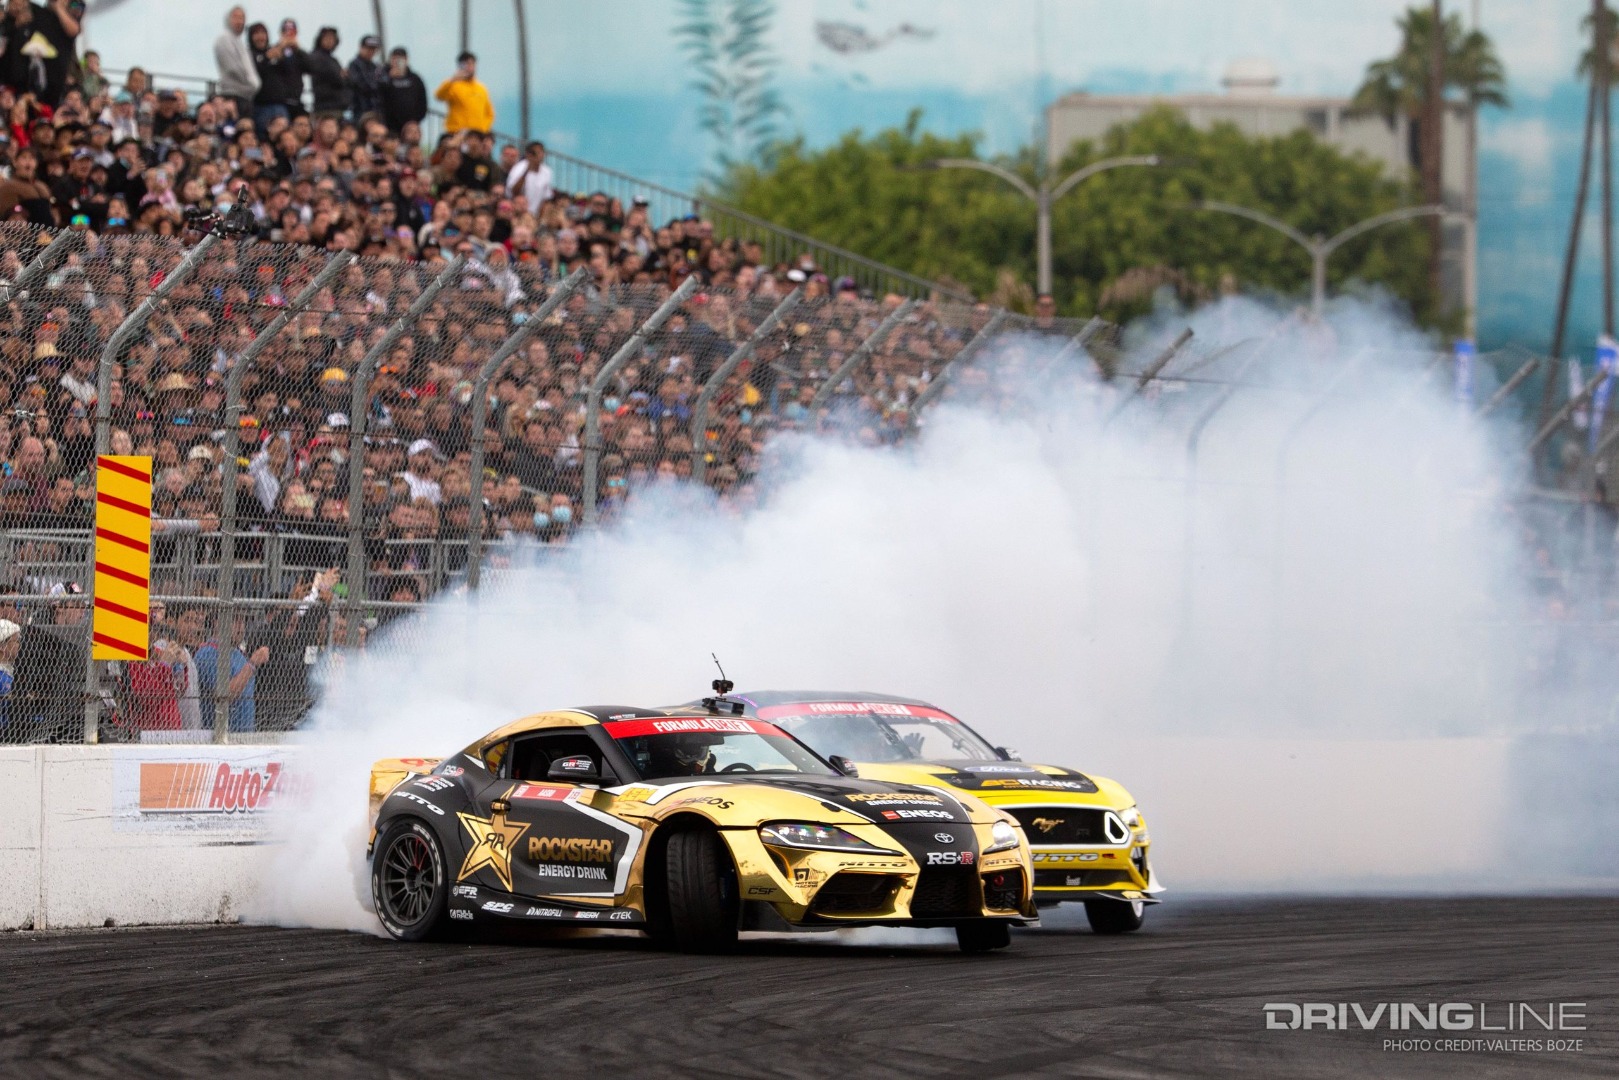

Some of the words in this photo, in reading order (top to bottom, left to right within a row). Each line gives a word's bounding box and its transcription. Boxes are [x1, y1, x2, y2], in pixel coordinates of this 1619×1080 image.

[653, 719, 714, 733] FORMULA
[710, 719, 755, 733] DRIFT
[1018, 779, 1081, 789] RACING
[845, 793, 944, 803] ROCKSTAR
[896, 809, 954, 820] ENEOS
[528, 836, 614, 863] ROCKSTAR
[1031, 853, 1099, 862] ITTO
[538, 863, 577, 878] ENERGY
[577, 865, 608, 880] DRINK
[748, 887, 777, 895] CSF
[609, 911, 632, 920] CTEK
